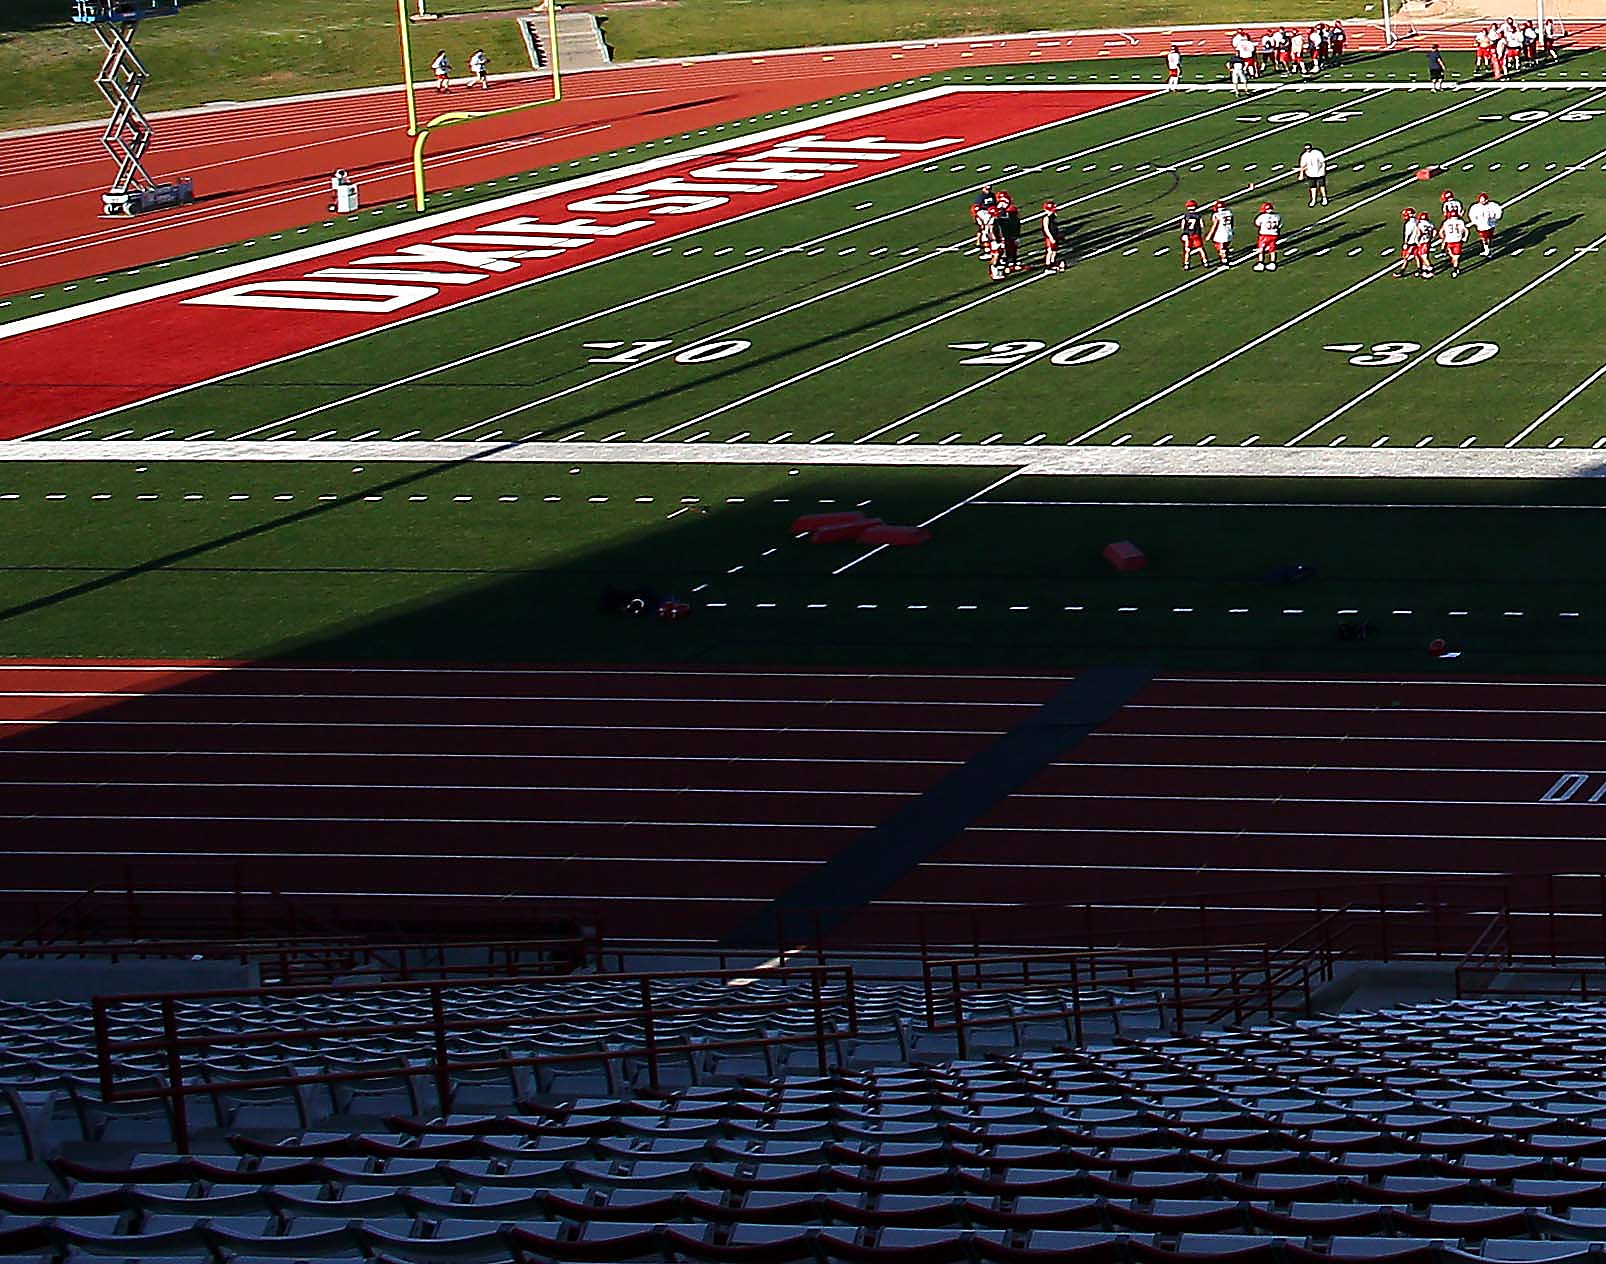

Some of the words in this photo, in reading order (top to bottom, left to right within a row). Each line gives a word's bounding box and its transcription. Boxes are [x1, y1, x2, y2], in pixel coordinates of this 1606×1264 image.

[179, 216, 656, 314] DIXIE
[566, 134, 966, 215] STATE
[588, 339, 752, 366] 10
[959, 339, 1120, 367] 20
[1347, 340, 1501, 368] 30
